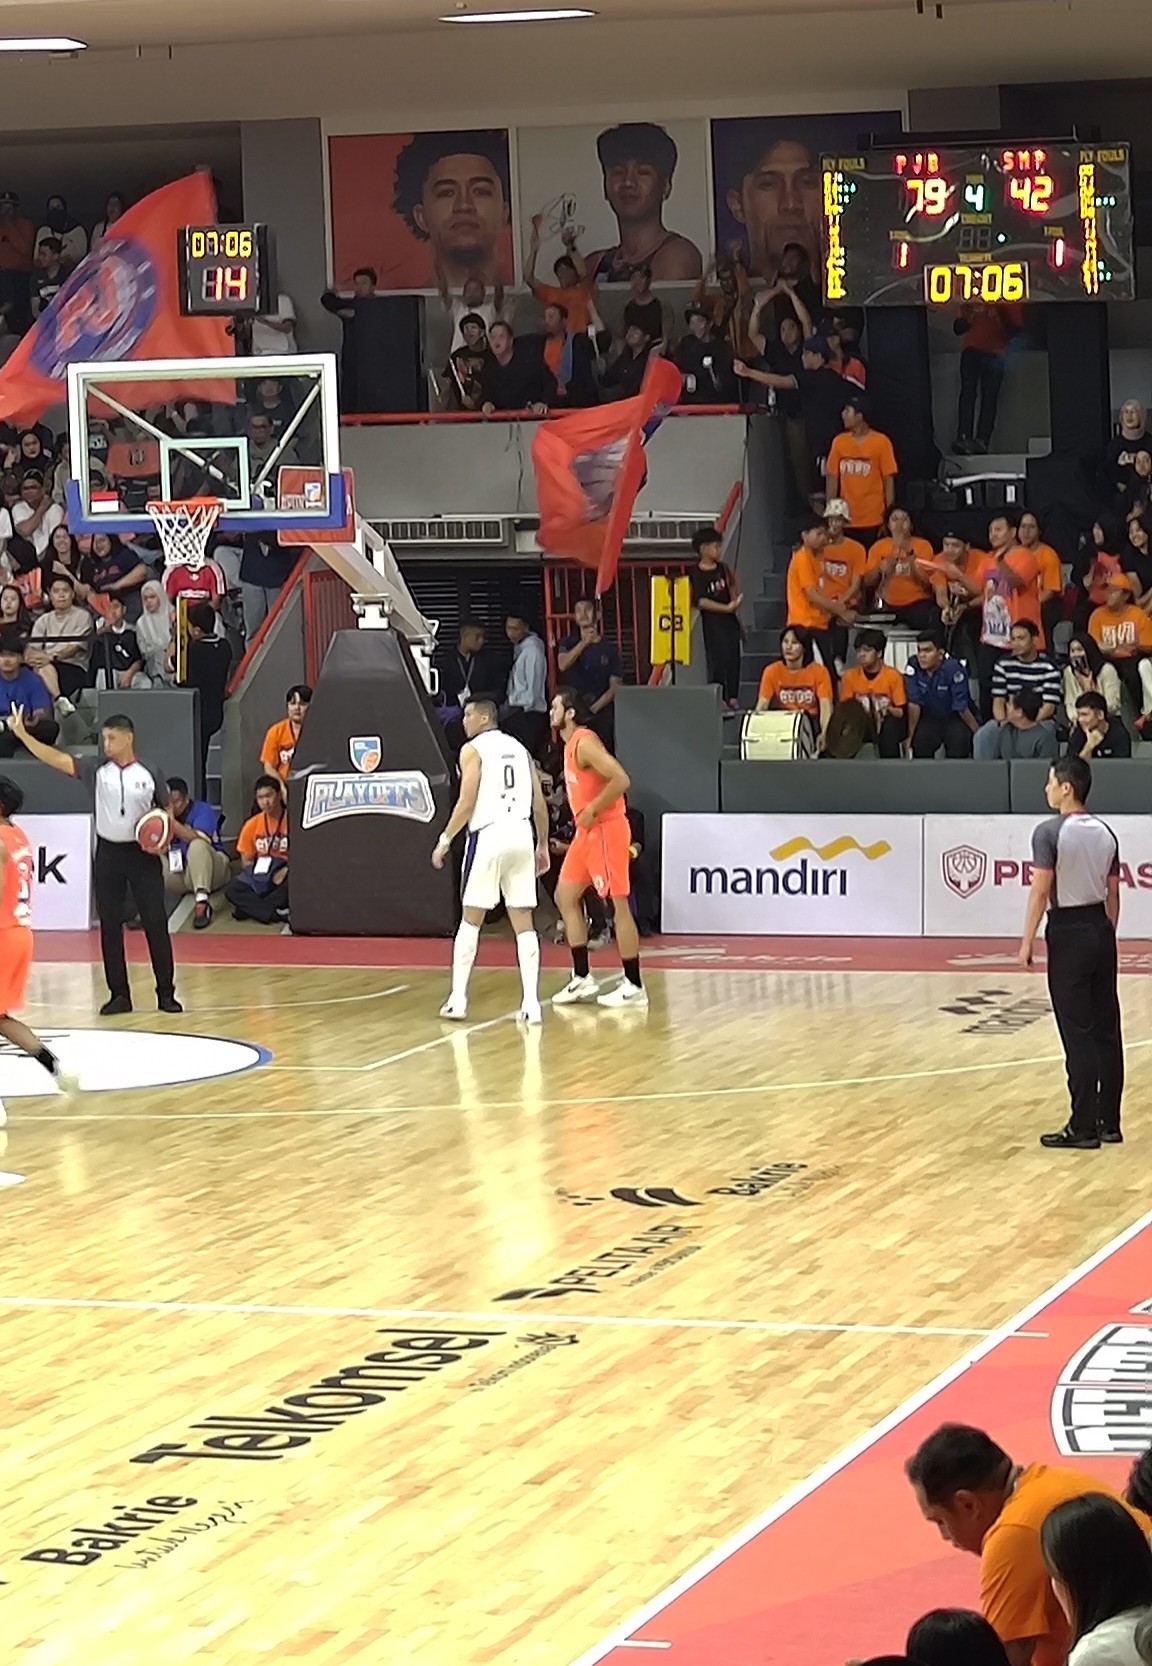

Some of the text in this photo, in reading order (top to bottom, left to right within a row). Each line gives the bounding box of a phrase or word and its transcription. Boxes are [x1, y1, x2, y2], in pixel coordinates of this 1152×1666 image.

[906, 178, 947, 215] 79
[964, 184, 985, 212] 4
[1009, 175, 1052, 212] 42
[191, 231, 252, 258] 07:06
[899, 242, 908, 268] 1
[1054, 238, 1065, 267] 1
[215, 266, 247, 301] 14
[929, 263, 1024, 303] 07:06
[503, 763, 515, 790] 0
[309, 780, 429, 818] PLAYOFFS
[689, 858, 848, 896] mandiri
[993, 859, 1152, 890] PEAS
[548, 1246, 667, 1286] PELITA
[129, 1328, 508, 1464] Telkomsel
[20, 1495, 198, 1567] Bakrie
